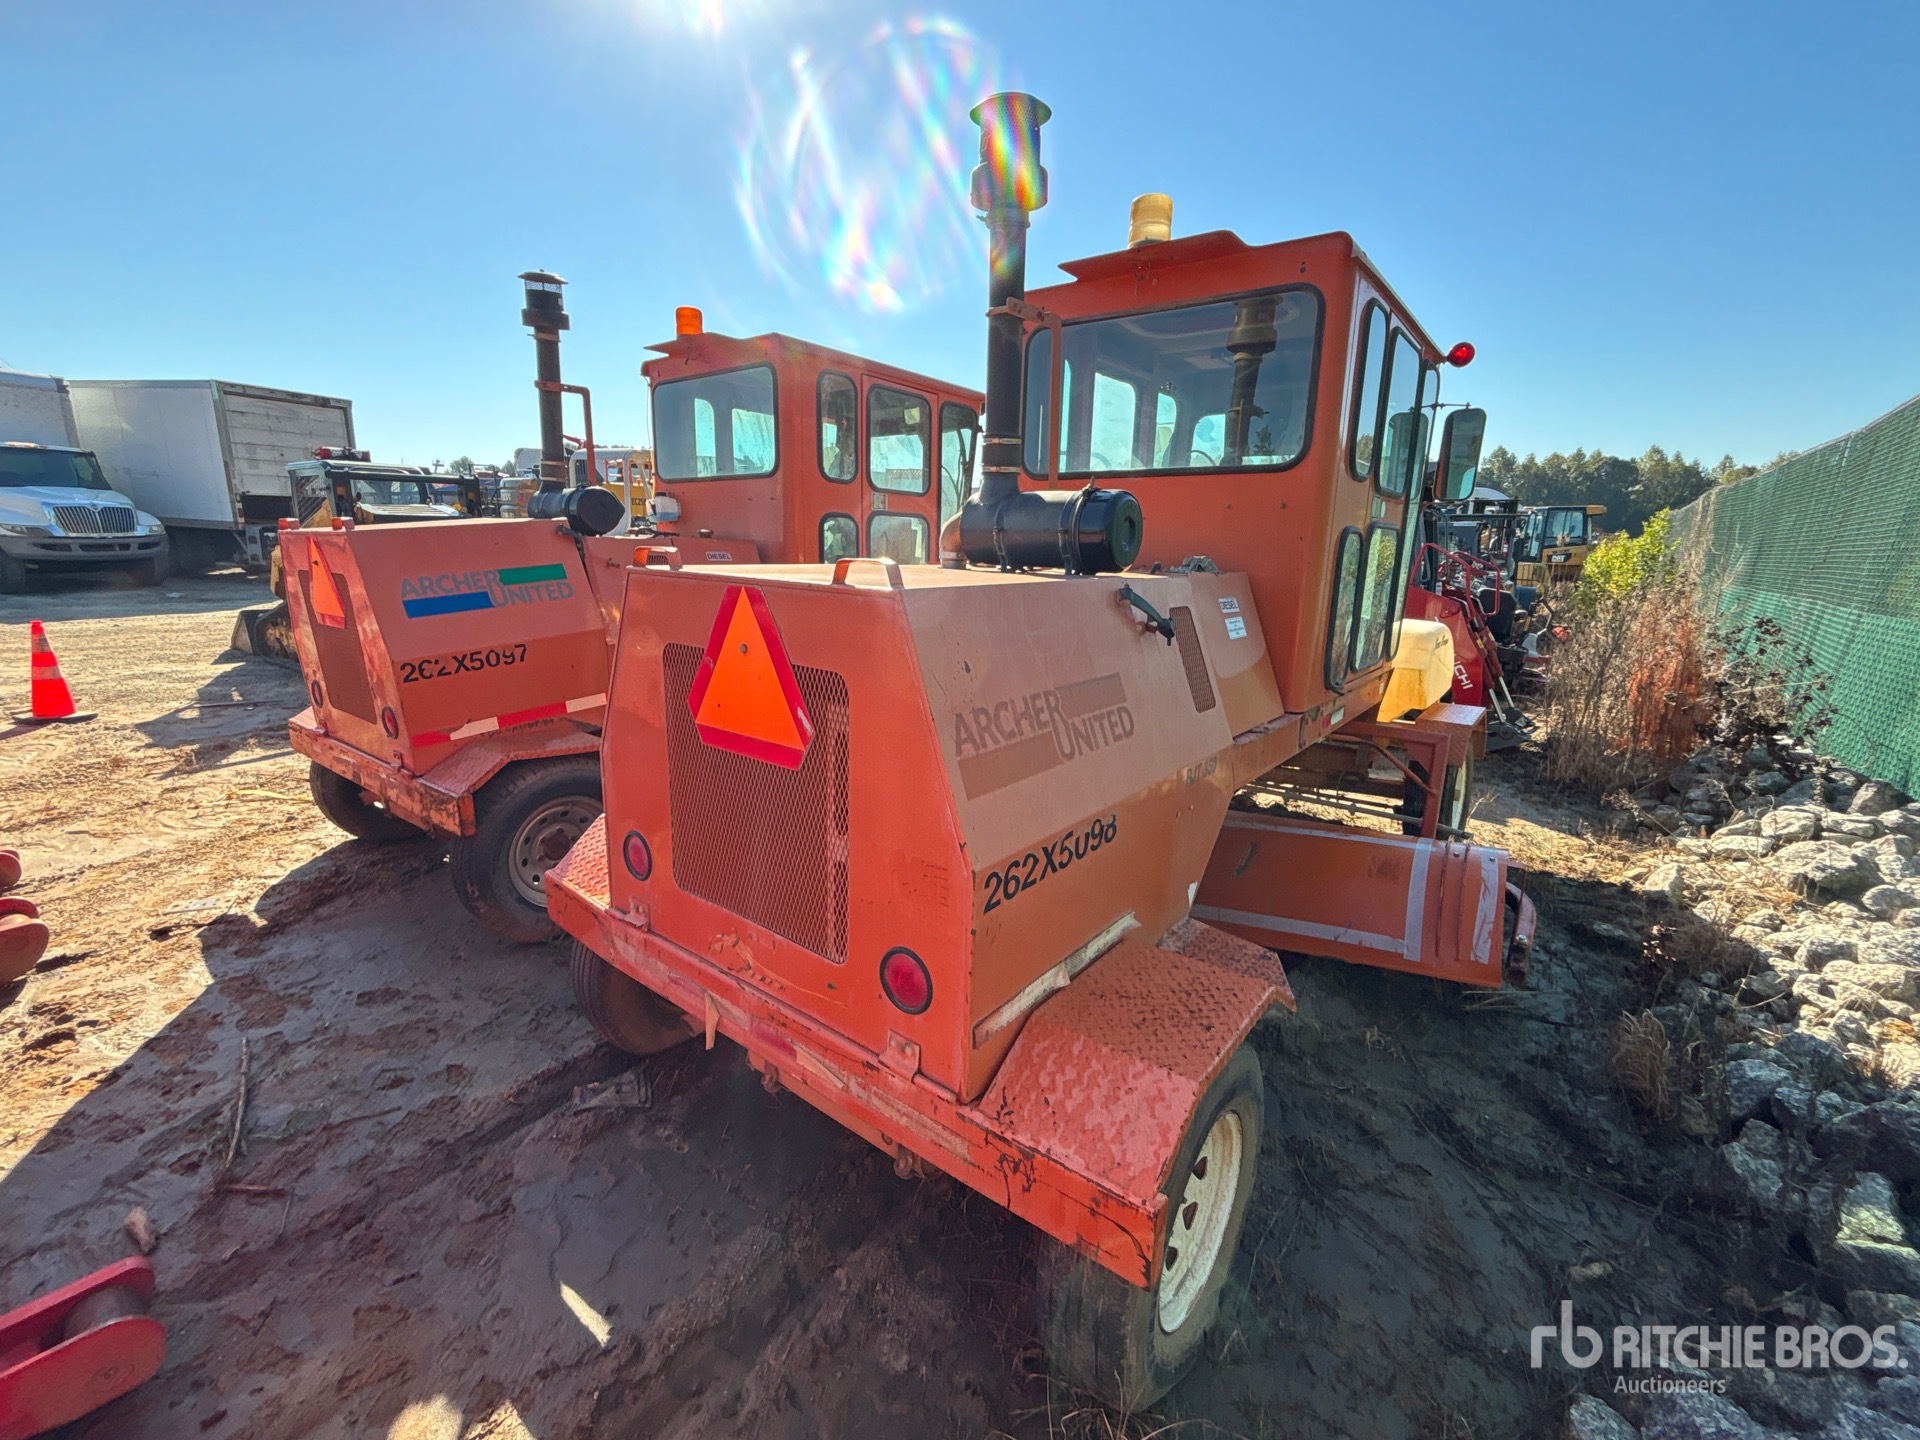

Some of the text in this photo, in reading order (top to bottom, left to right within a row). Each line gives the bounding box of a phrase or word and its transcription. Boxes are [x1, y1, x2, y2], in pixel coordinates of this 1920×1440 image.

[1551, 554, 1566, 563] CAT
[401, 569, 501, 599] ARCHER
[488, 582, 574, 608] UNITED
[1220, 600, 1239, 610] DIESEL
[400, 643, 528, 683] 262X5097
[954, 689, 1062, 757] ARCHER
[1051, 706, 1135, 760] UNITED
[983, 814, 1118, 915] 262X5098
